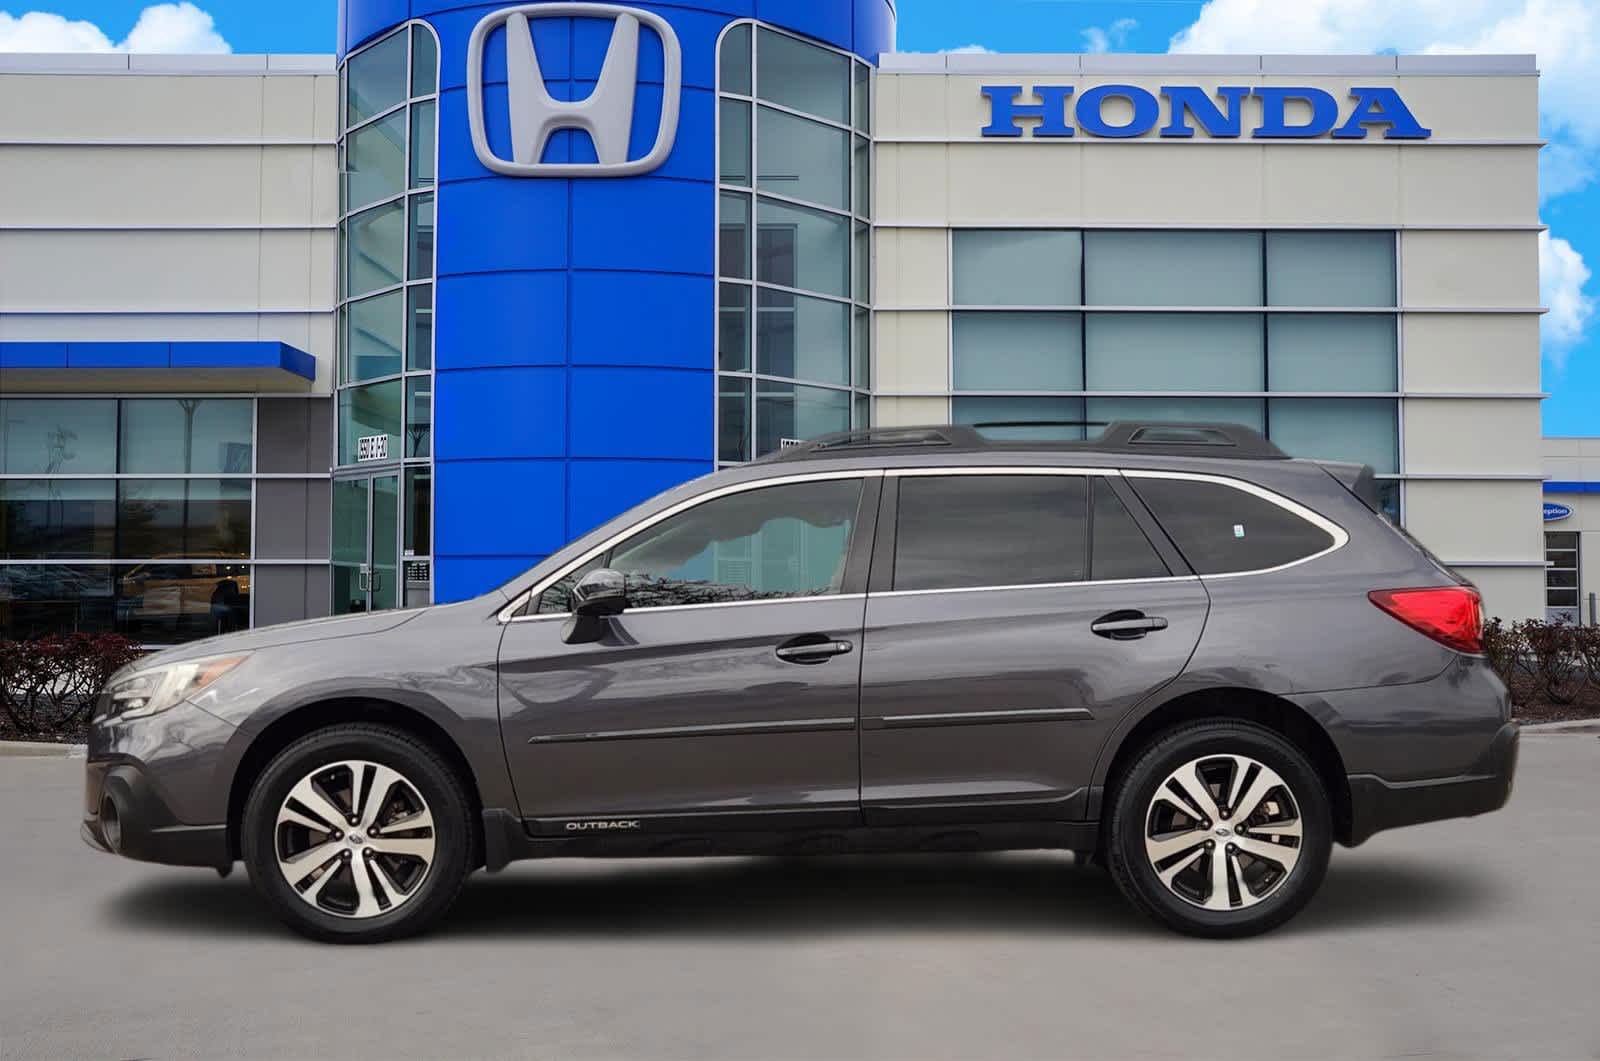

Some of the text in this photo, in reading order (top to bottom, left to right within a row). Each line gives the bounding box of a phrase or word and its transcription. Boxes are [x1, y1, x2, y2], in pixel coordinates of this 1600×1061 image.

[505, 11, 640, 165] H
[981, 84, 1432, 139] HONDA
[1543, 507, 1568, 515] eption
[566, 820, 640, 830] OUTBACK
